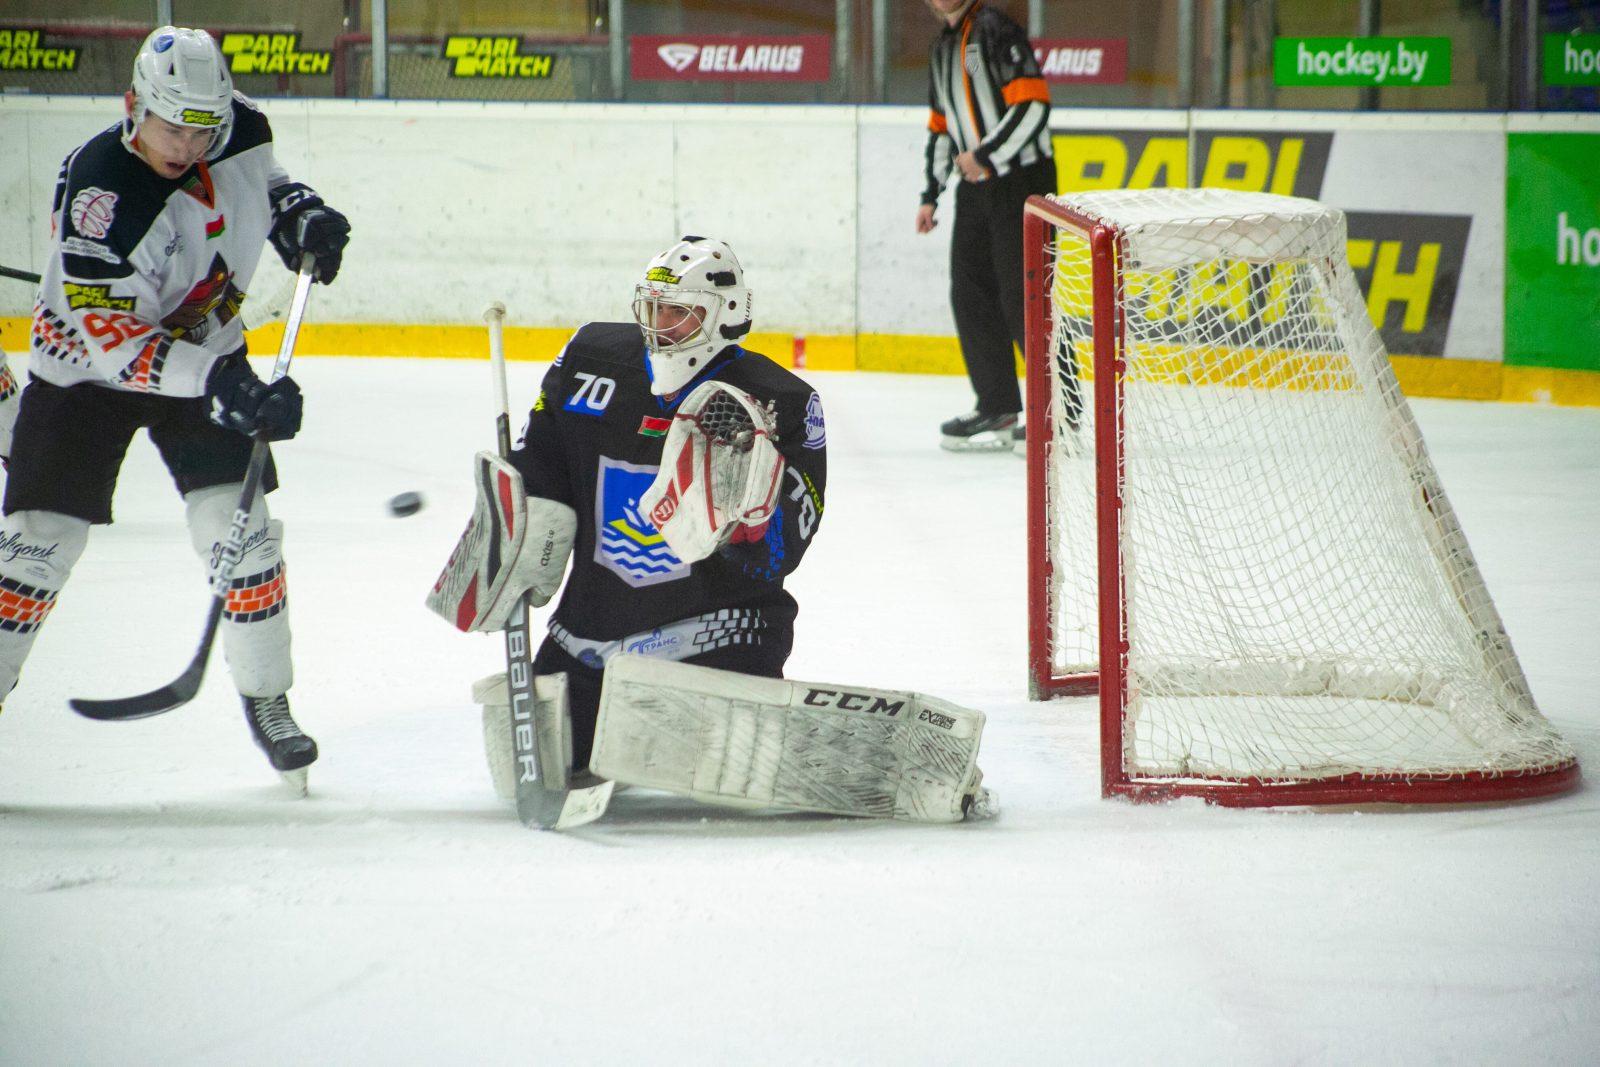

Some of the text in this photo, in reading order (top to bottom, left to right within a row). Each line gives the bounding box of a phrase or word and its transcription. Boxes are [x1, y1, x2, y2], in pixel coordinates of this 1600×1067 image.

[0, 30, 40, 49] ARI
[222, 34, 296, 53] PARI
[446, 37, 517, 57] PARI
[231, 52, 330, 72] MATCH
[455, 55, 550, 77] MATCH
[698, 45, 803, 72] BELARUS
[1034, 47, 1103, 75] ARUS
[1297, 41, 1429, 82] hockey.by
[569, 371, 616, 411] 70
[786, 465, 816, 541] 70
[803, 688, 905, 717] CCM
